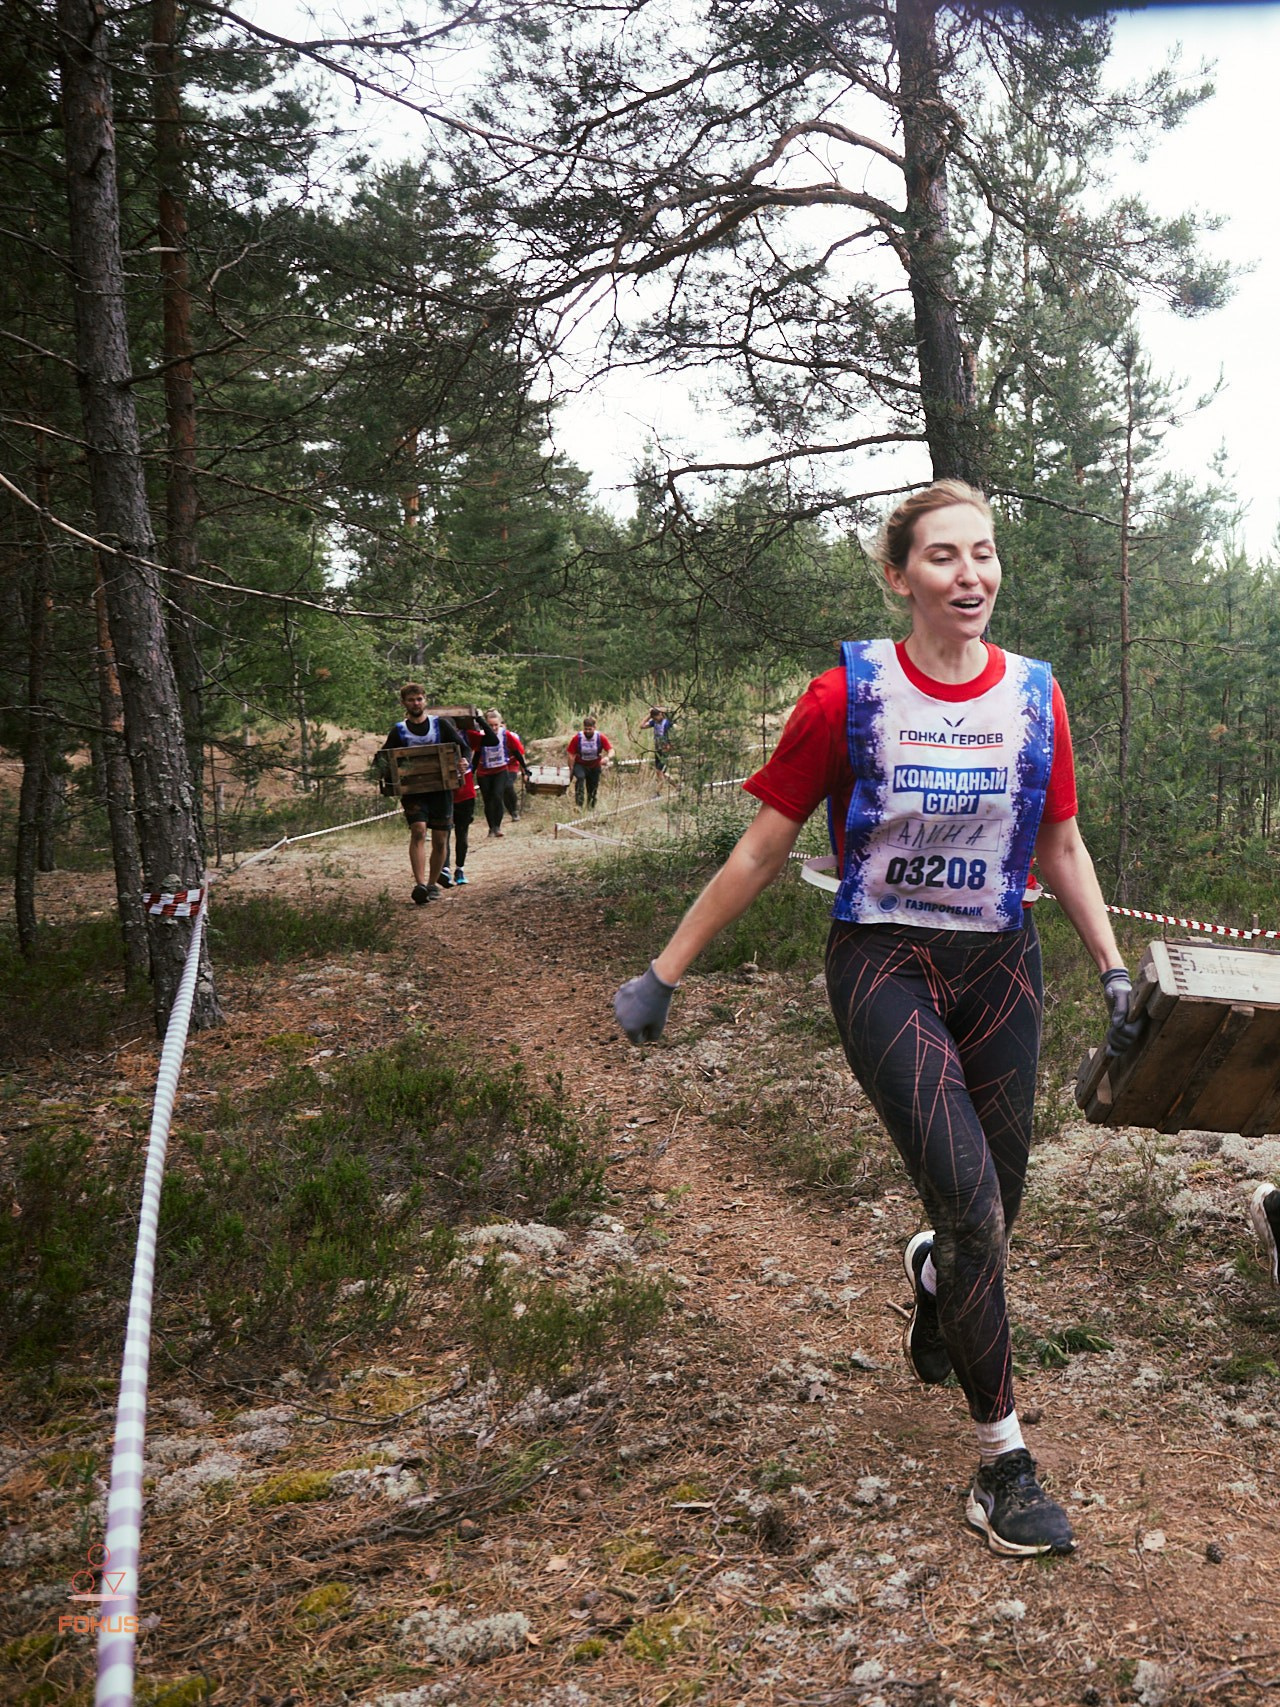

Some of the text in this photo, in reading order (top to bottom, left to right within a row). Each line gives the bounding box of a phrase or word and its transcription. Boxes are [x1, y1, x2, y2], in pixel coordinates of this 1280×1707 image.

[899, 730, 1004, 745] ГОНКА ГЕРОЕВ
[895, 767, 1006, 794] КОМАНДНЫЙ
[926, 792, 977, 813] СТАРТ
[897, 821, 987, 849] АЛИНА
[885, 854, 987, 891] 03208
[905, 899, 984, 917] ГАЗПРОМБАНК
